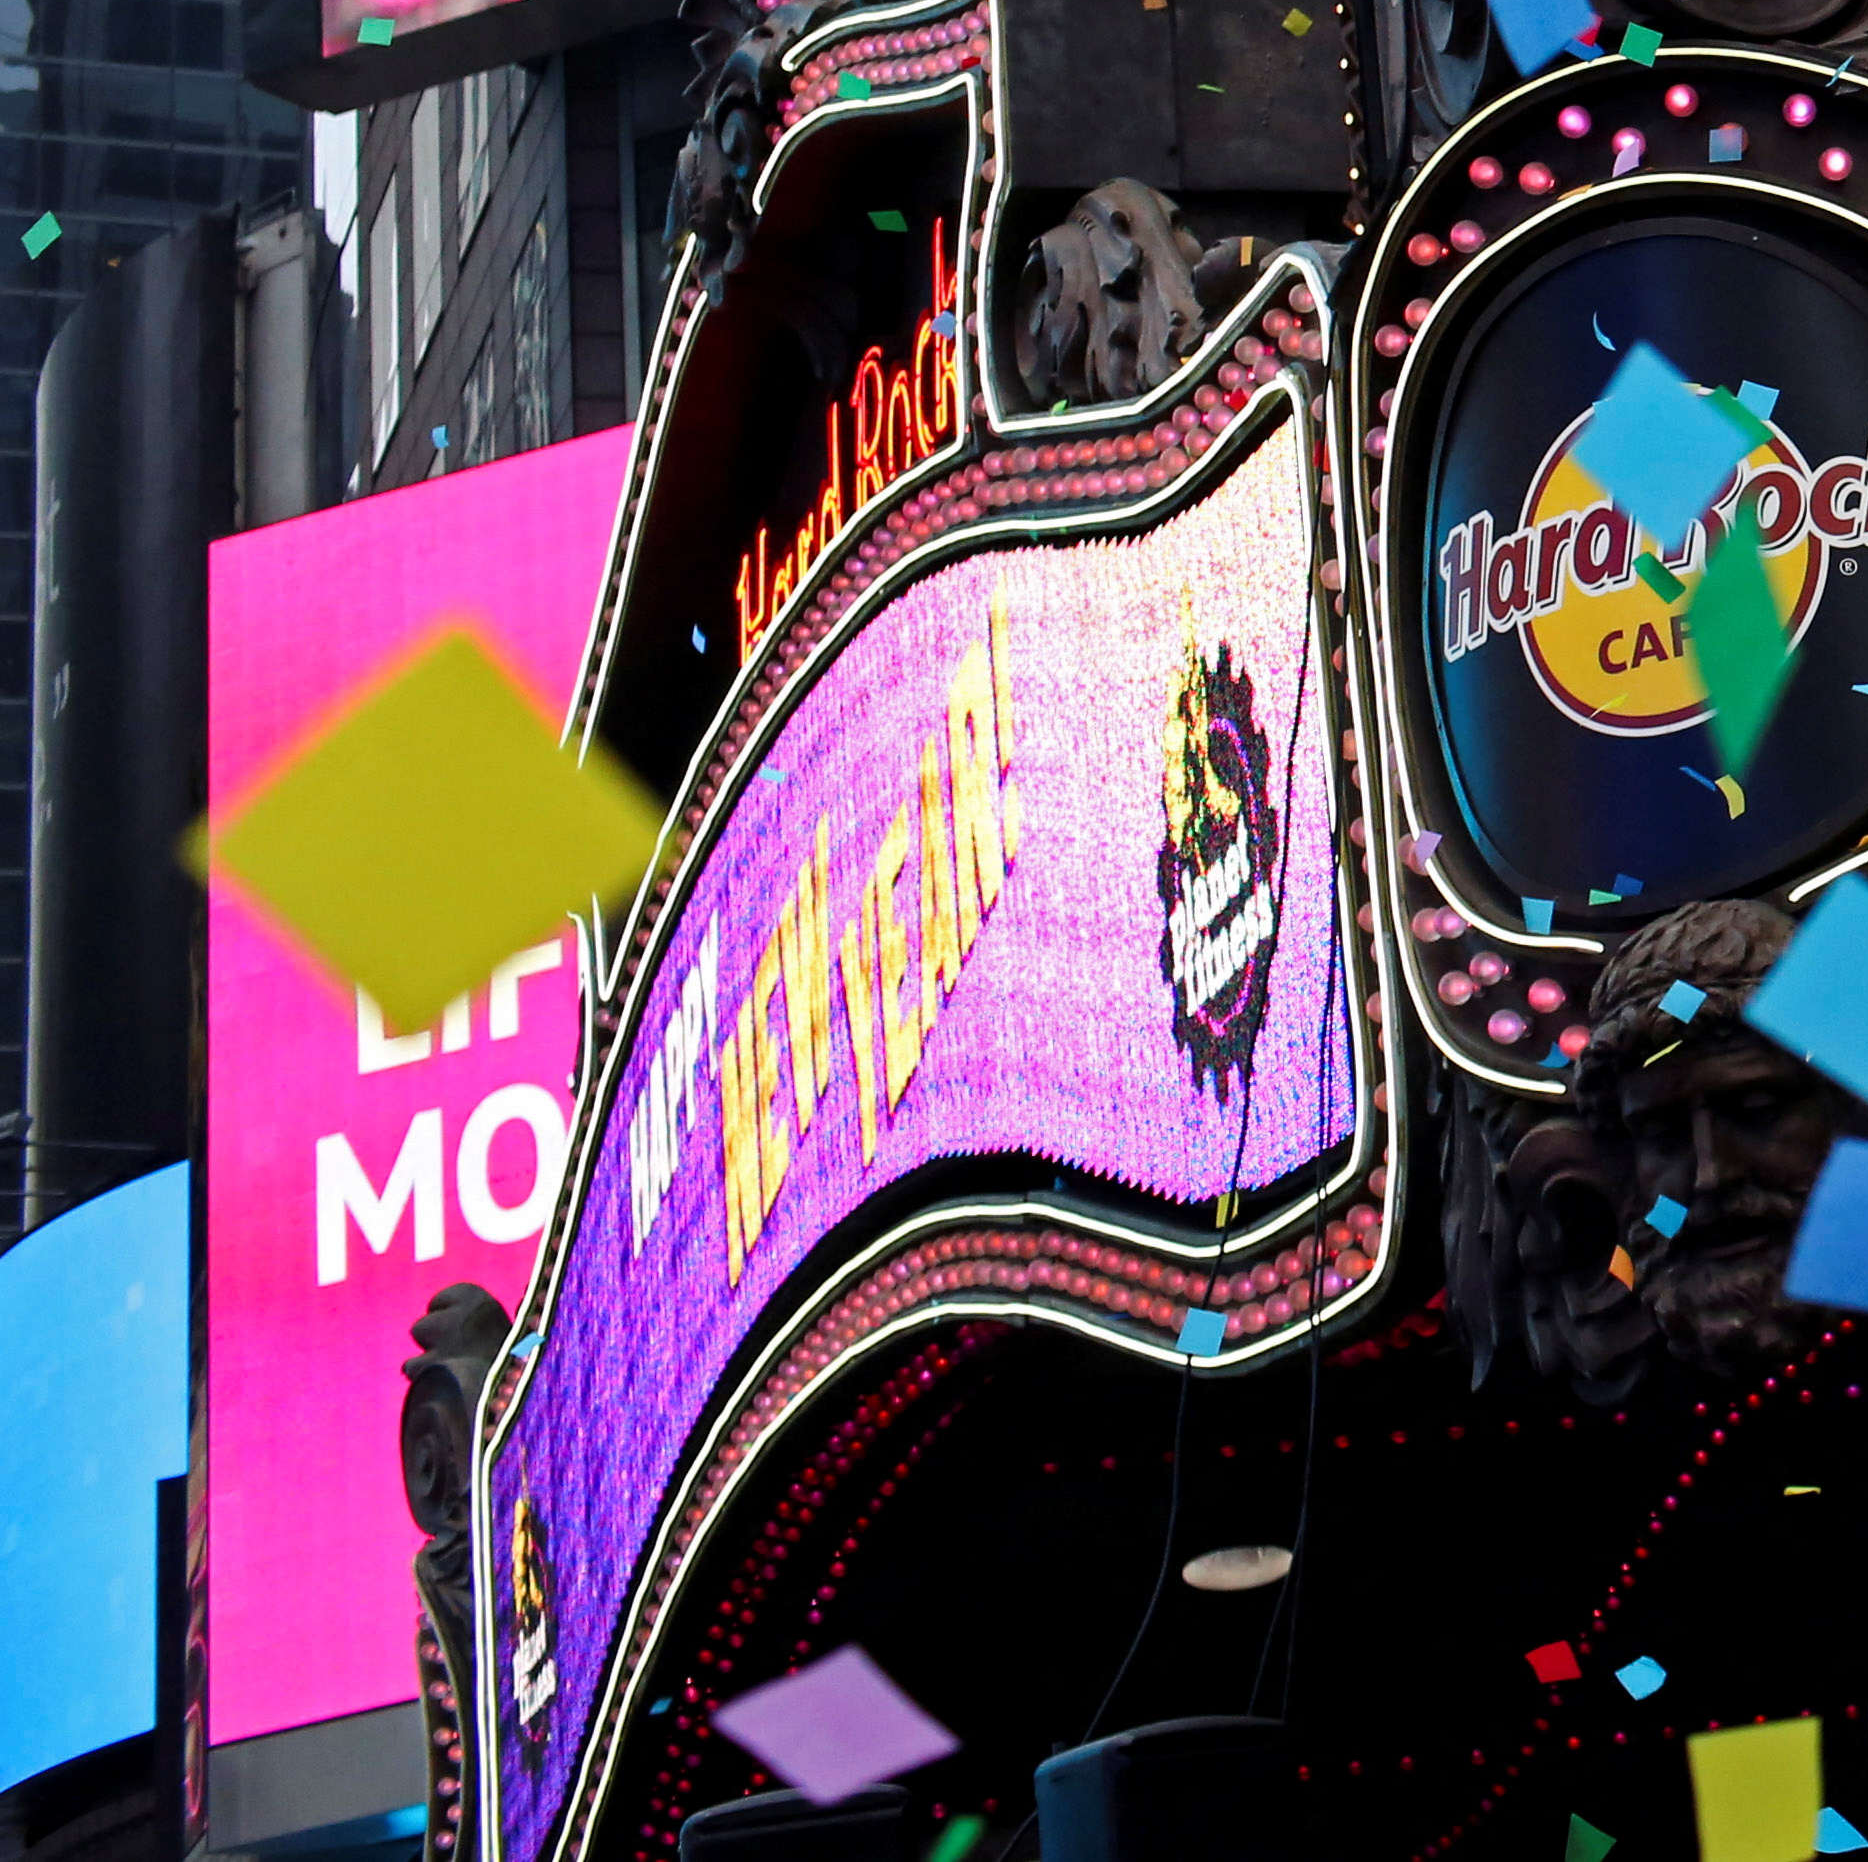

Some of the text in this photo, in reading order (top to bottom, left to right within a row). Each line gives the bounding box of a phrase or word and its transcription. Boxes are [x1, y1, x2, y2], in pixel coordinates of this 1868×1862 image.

[1597, 618, 1690, 676] CAF
[719, 570, 1021, 1288] NEW YEAR!
[1168, 811, 1250, 984] planet
[1184, 880, 1274, 1018] fitness
[315, 1072, 577, 1287] MO
[629, 908, 719, 1260] HAPPY
